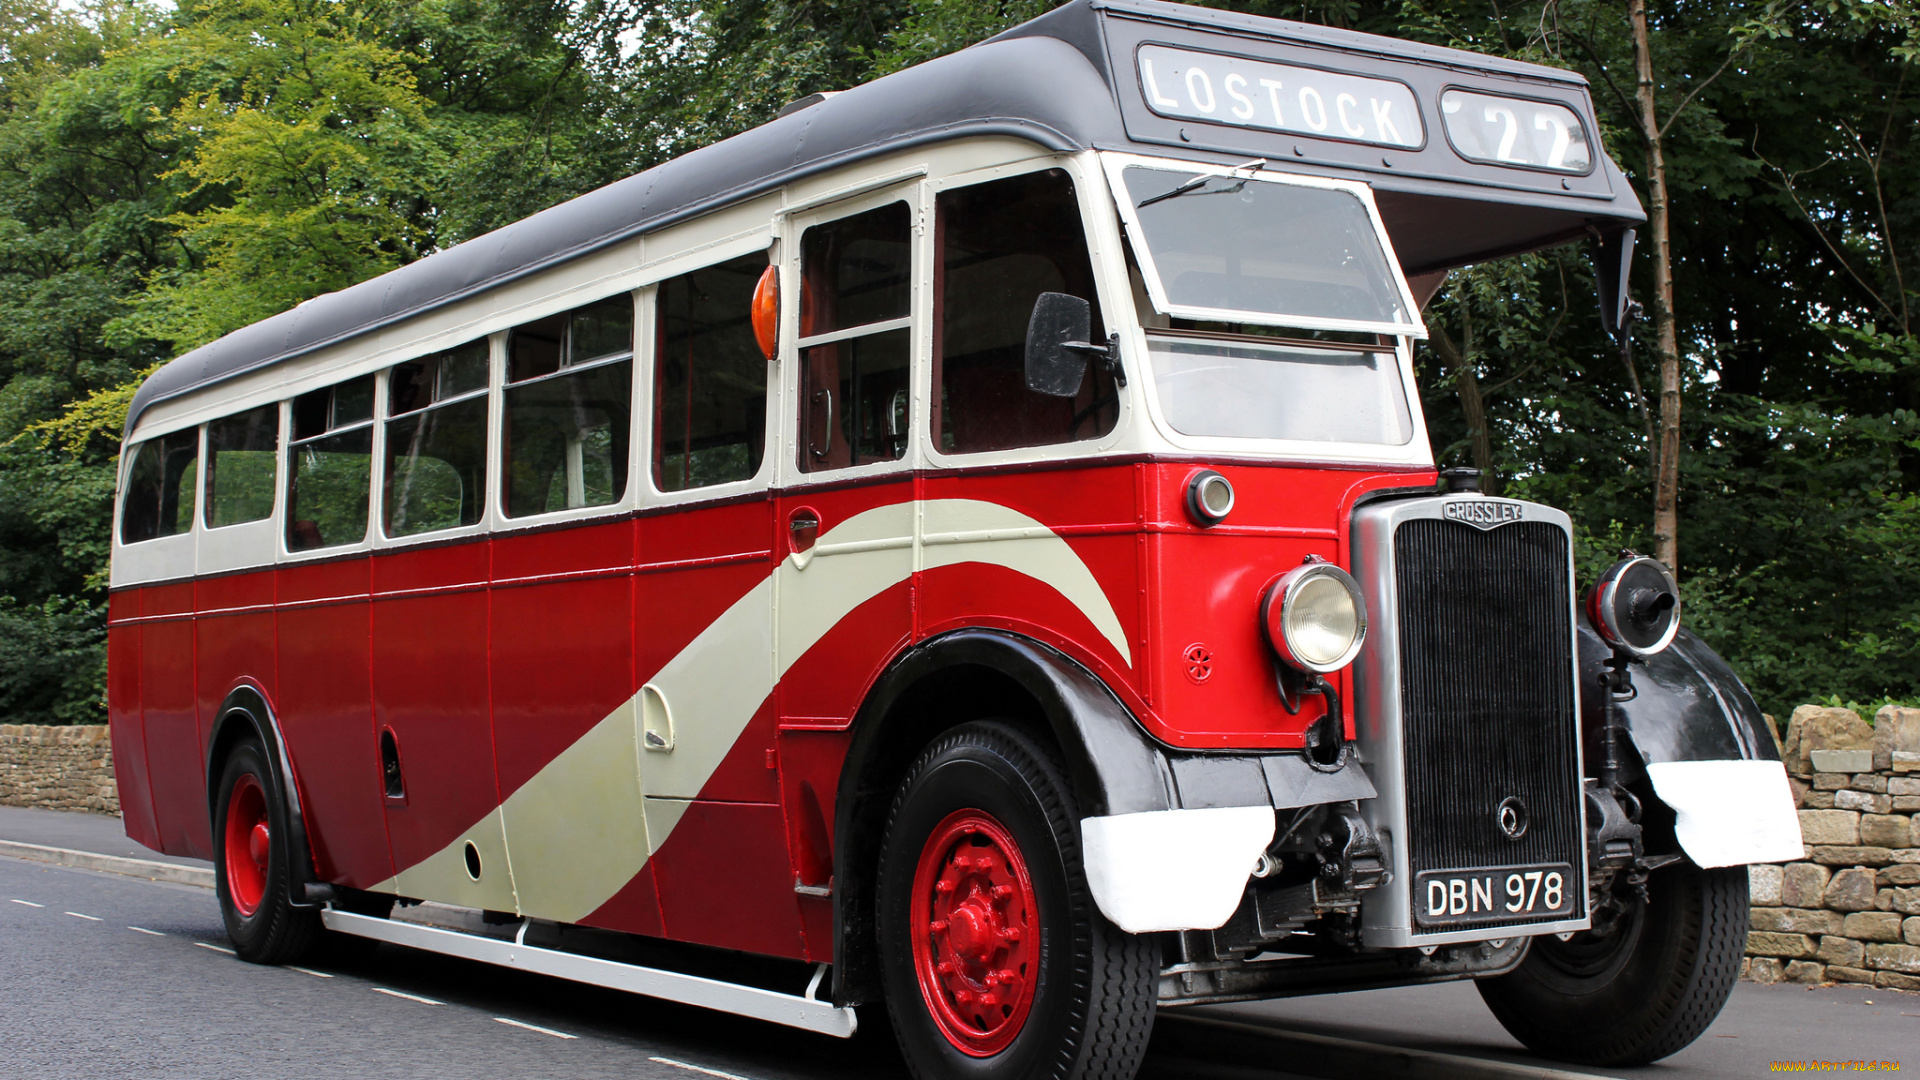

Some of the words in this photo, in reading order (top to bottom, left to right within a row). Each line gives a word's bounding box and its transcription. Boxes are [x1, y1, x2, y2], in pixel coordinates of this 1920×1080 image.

[1144, 58, 1404, 144] LOSTOCK
[1446, 502, 1521, 523] CROSSLEY
[1427, 877, 1493, 916] DBN
[1505, 871, 1563, 913] 978
